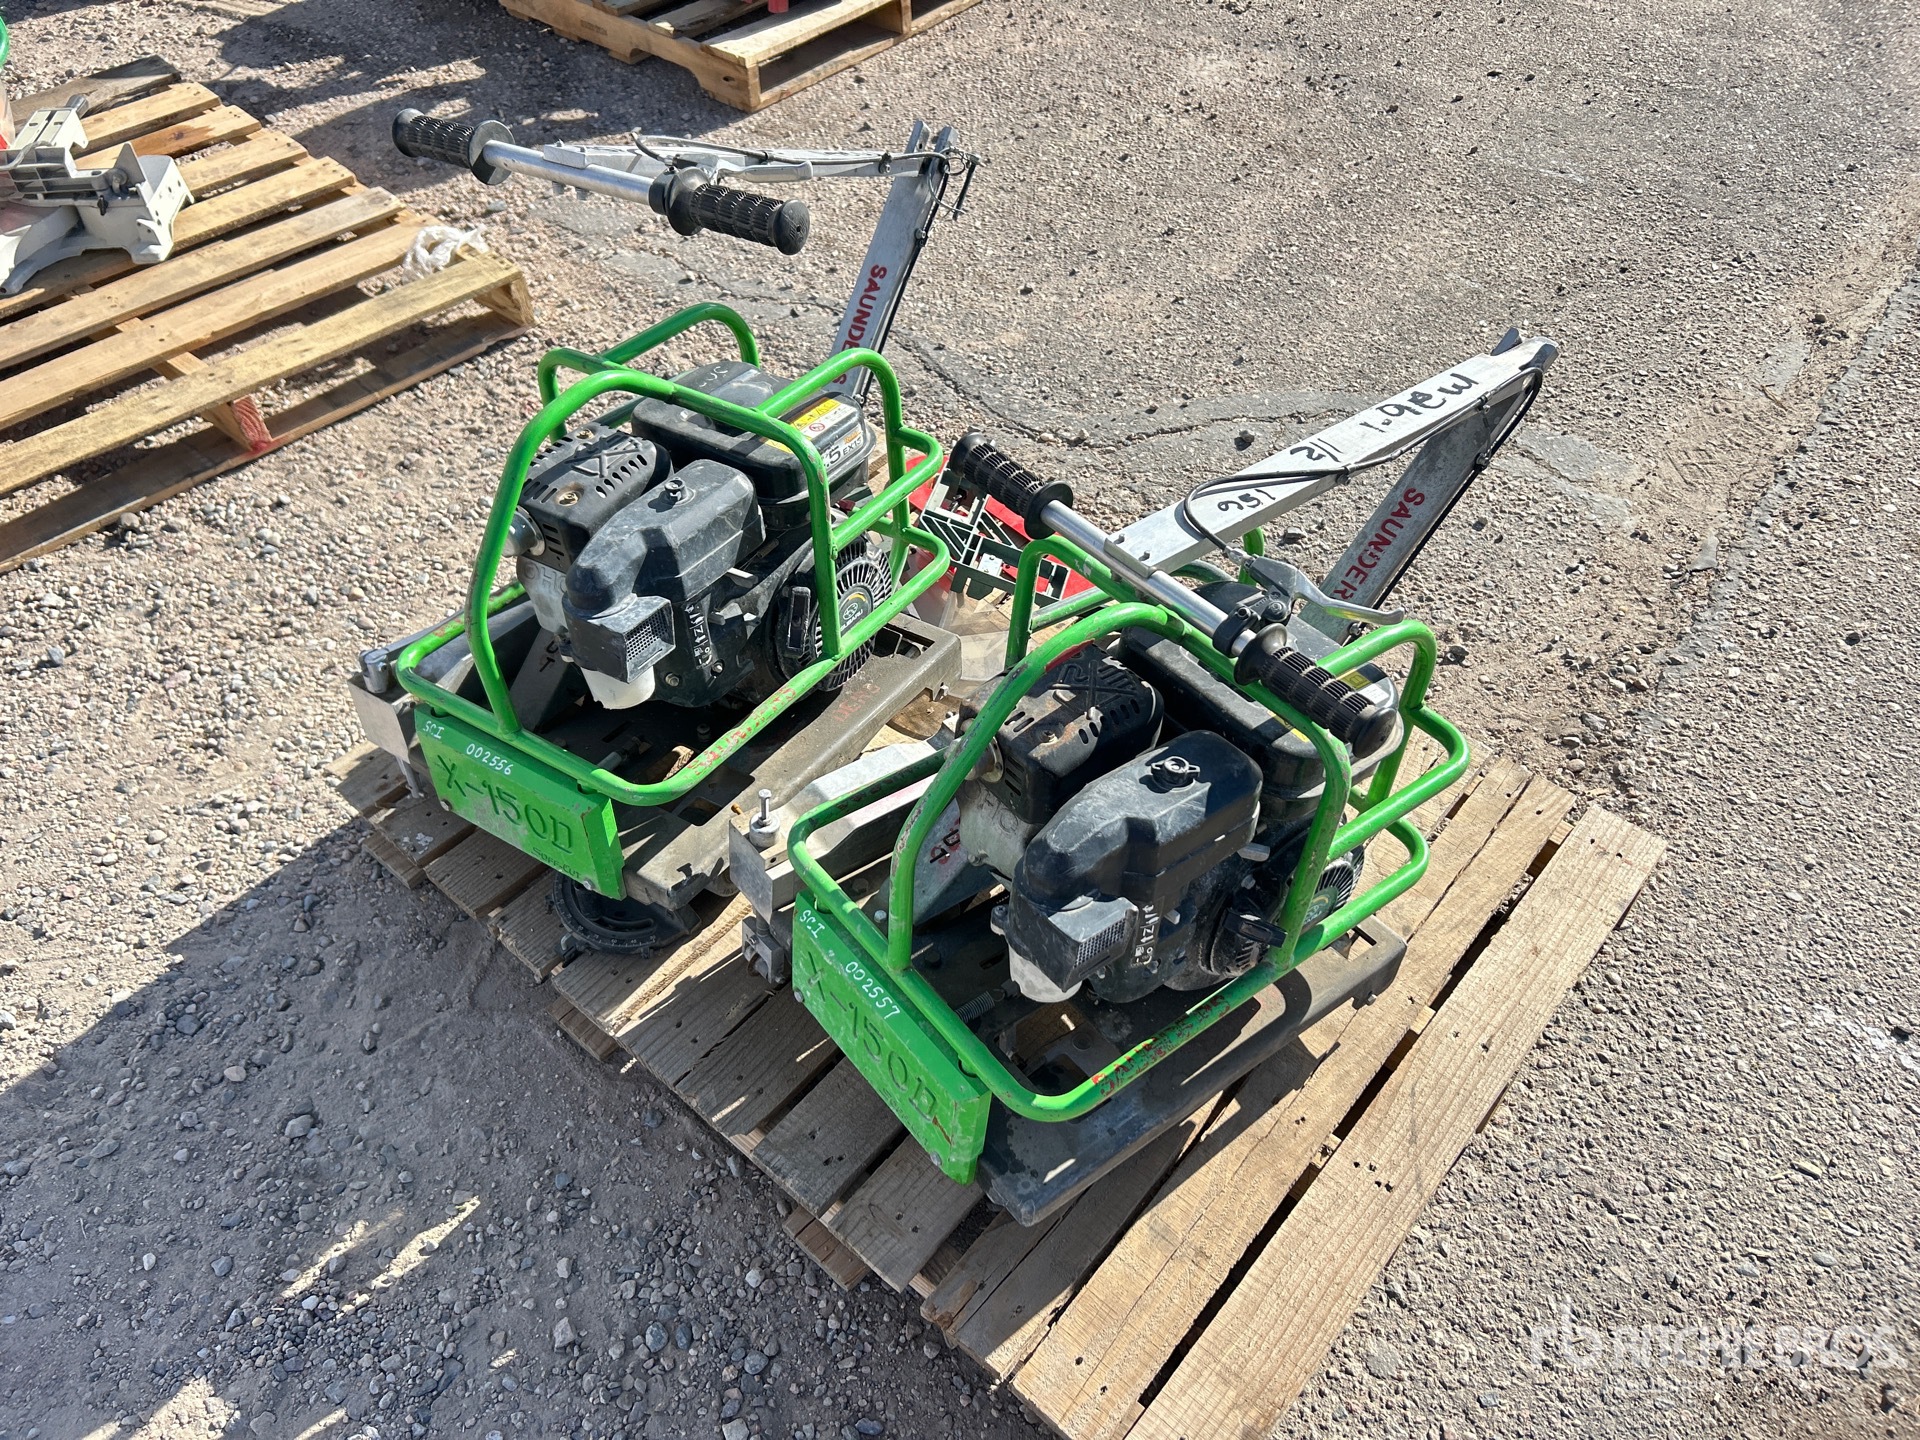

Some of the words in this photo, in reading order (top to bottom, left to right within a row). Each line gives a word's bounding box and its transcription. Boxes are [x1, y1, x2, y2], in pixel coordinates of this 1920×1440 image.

[833, 264, 888, 385] SAUNDES
[436, 753, 574, 855] X-150D
[465, 742, 514, 777] 002556
[806, 950, 939, 1122] X-150D
[844, 961, 902, 1020] 002557
